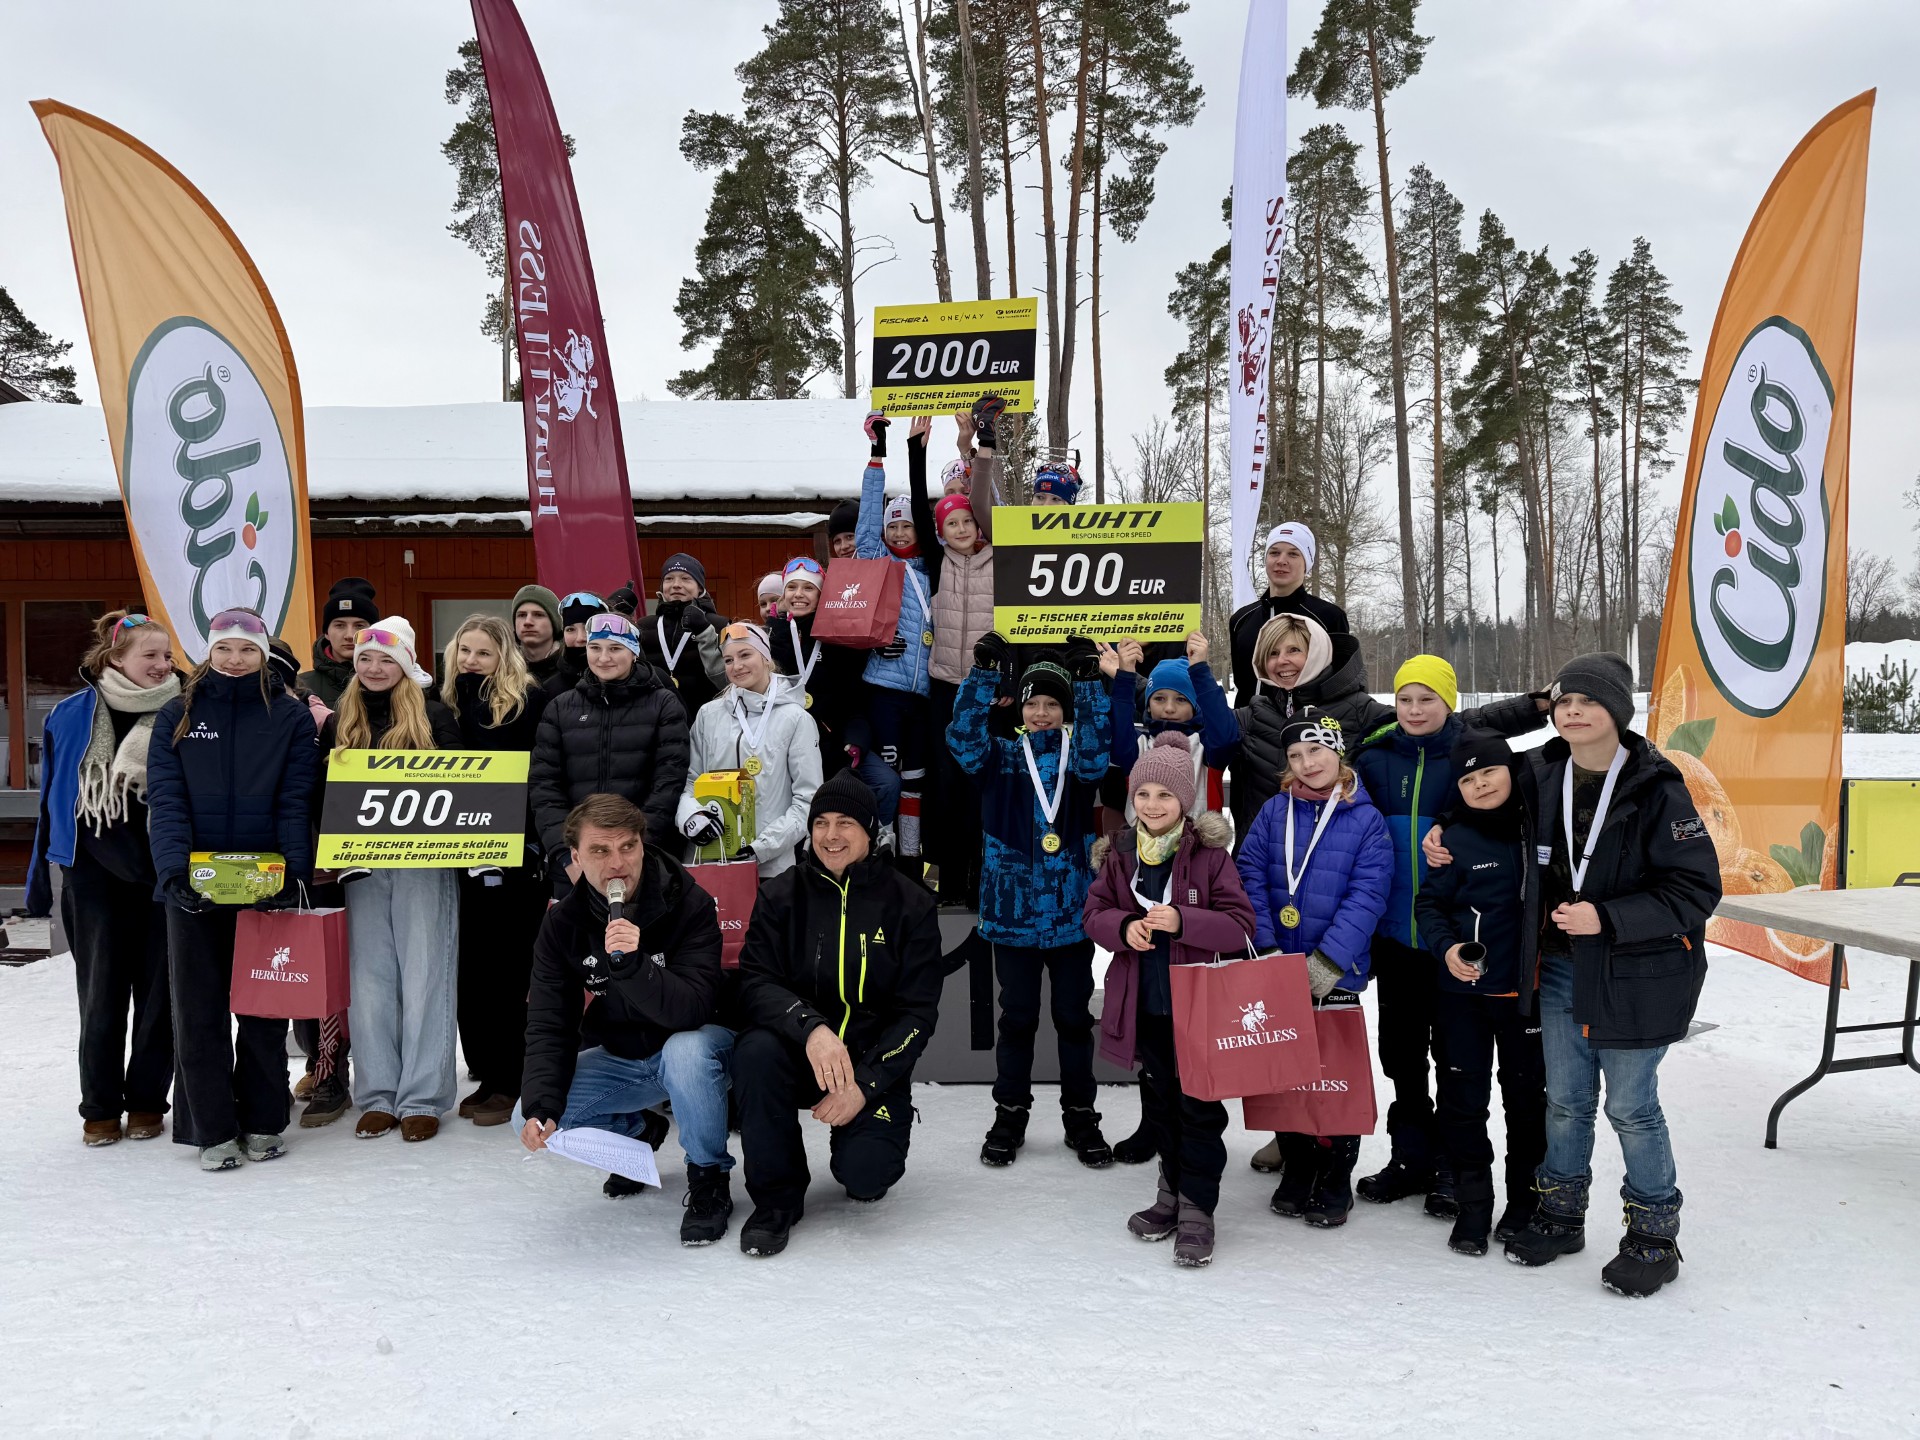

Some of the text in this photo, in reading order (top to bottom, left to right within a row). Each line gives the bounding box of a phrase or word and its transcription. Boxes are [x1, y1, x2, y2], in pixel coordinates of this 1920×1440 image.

[880, 316, 921, 324] FISCHER
[886, 338, 1020, 380] 2000 EUR
[905, 392, 944, 400] FISCHER
[946, 390, 980, 399] ziemas
[882, 401, 934, 412] slēpošanas
[1031, 510, 1163, 530] VAUHTI
[1709, 361, 1808, 673] Cido
[1028, 552, 1166, 597] 500 EUR
[824, 600, 868, 609] HERKULESS
[1017, 614, 1028, 622] S!
[1040, 613, 1088, 622] FISCHER
[1090, 612, 1134, 621] ziemas
[1137, 612, 1184, 621] skolēnu
[1010, 624, 1184, 636] slēpošanas čempionāts 2026
[367, 755, 493, 770] VAUHTI
[356, 789, 492, 827] 500 EUR
[416, 840, 460, 848] ziemas
[462, 840, 508, 848] skolēnu
[332, 851, 508, 863] slēpošanas čempionāts 2026
[194, 868, 214, 878] Cido
[250, 969, 309, 983] HERKULESS
[1216, 1028, 1298, 1050] HERKULESS
